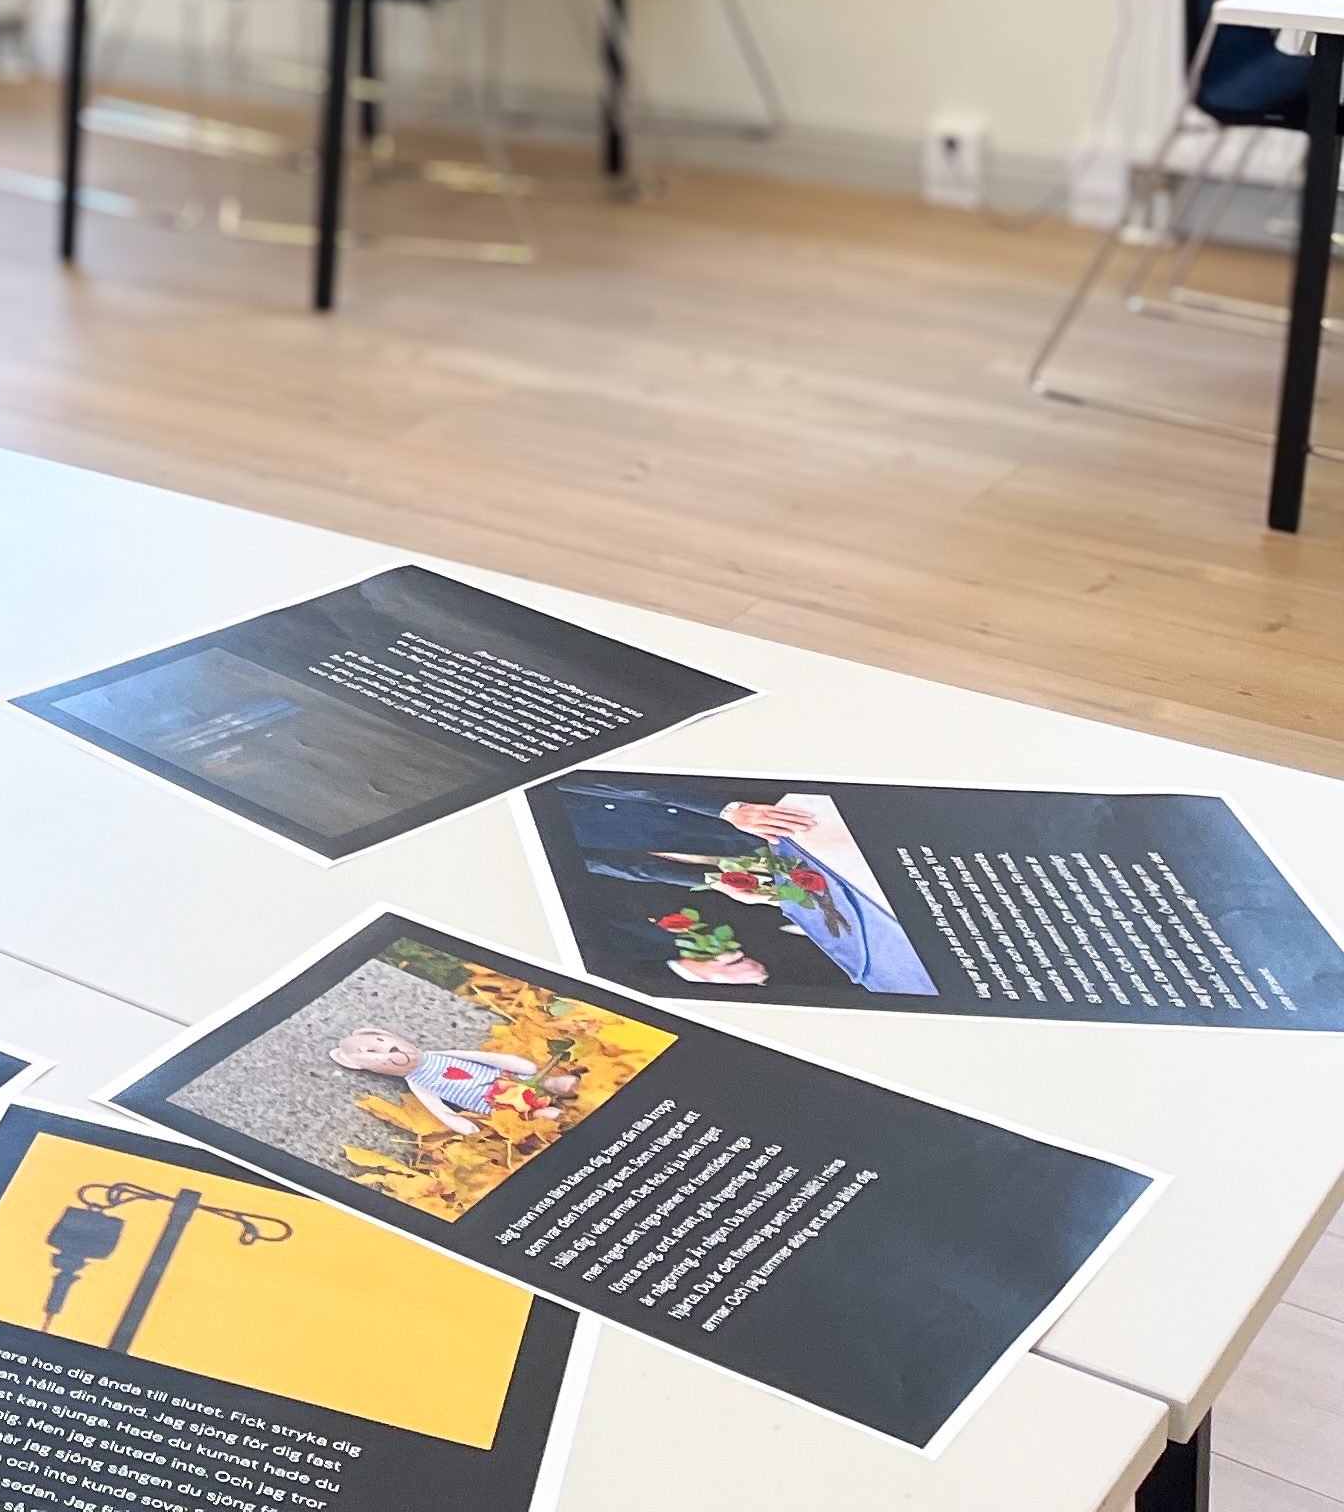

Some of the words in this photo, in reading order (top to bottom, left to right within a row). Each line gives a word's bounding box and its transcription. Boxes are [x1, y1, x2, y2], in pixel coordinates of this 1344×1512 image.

[495, 1229, 520, 1244] Jag
[509, 1212, 539, 1231] hann
[530, 1198, 555, 1214] inte
[562, 1166, 595, 1186] känna
[601, 1141, 627, 1156] bara
[622, 1130, 641, 1142] din
[645, 1100, 676, 1120] kropp
[525, 1239, 549, 1256] som
[543, 1226, 562, 1239] var
[557, 1212, 580, 1228] den
[599, 1179, 623, 1193] jag
[629, 1151, 655, 1167] Som
[654, 1122, 689, 1146] längtat
[684, 1111, 701, 1123] att
[550, 1250, 578, 1269] hålla
[573, 1237, 596, 1251] dig
[591, 1218, 615, 1234] våra
[610, 1197, 640, 1219] armar.
[631, 1184, 655, 1198] Det
[646, 1173, 669, 1186] fick
[678, 1144, 704, 1160] Men
[695, 1127, 722, 1145] inget
[17, 1394, 47, 1410] kan
[52, 1406, 110, 1428] sjunga.
[117, 1422, 163, 1442] Hade
[168, 1438, 192, 1450] du
[197, 1444, 259, 1469] kunnat
[264, 1462, 310, 1484] hade
[315, 1479, 340, 1492] du
[26, 1376, 65, 1394] hålla
[70, 1390, 96, 1404] din
[101, 1397, 147, 1418] hand.
[153, 1413, 185, 1430] Jag
[190, 1423, 238, 1445] sjöng
[243, 1436, 269, 1450] för
[273, 1446, 302, 1462] dig
[307, 1453, 341, 1472] fast
[32, 1357, 63, 1374] hos
[67, 1369, 94, 1384] dig
[98, 1377, 141, 1395] ända
[147, 1390, 168, 1402] till
[171, 1398, 224, 1418] slutet.
[230, 1411, 266, 1430] Fick
[272, 1425, 327, 1446] stryka
[333, 1441, 362, 1457] dig
[1, 1479, 58, 1502] sedan.
[64, 1496, 97, 1512] Jag
[7, 1458, 39, 1473] och
[44, 1466, 77, 1484] inte
[82, 1477, 136, 1501] kunde
[22, 1439, 52, 1457] jag
[55, 1450, 104, 1472] sjöng
[108, 1465, 172, 1489] sången
[177, 1484, 202, 1497] du
[207, 1492, 256, 1512] sjöng
[27, 1418, 64, 1436] Men
[66, 1429, 96, 1447] jag
[100, 1440, 166, 1464] slutade
[171, 1458, 208, 1478] inte.
[215, 1471, 253, 1490] Och
[256, 1482, 286, 1501] jag
[292, 1493, 326, 1509] tror
